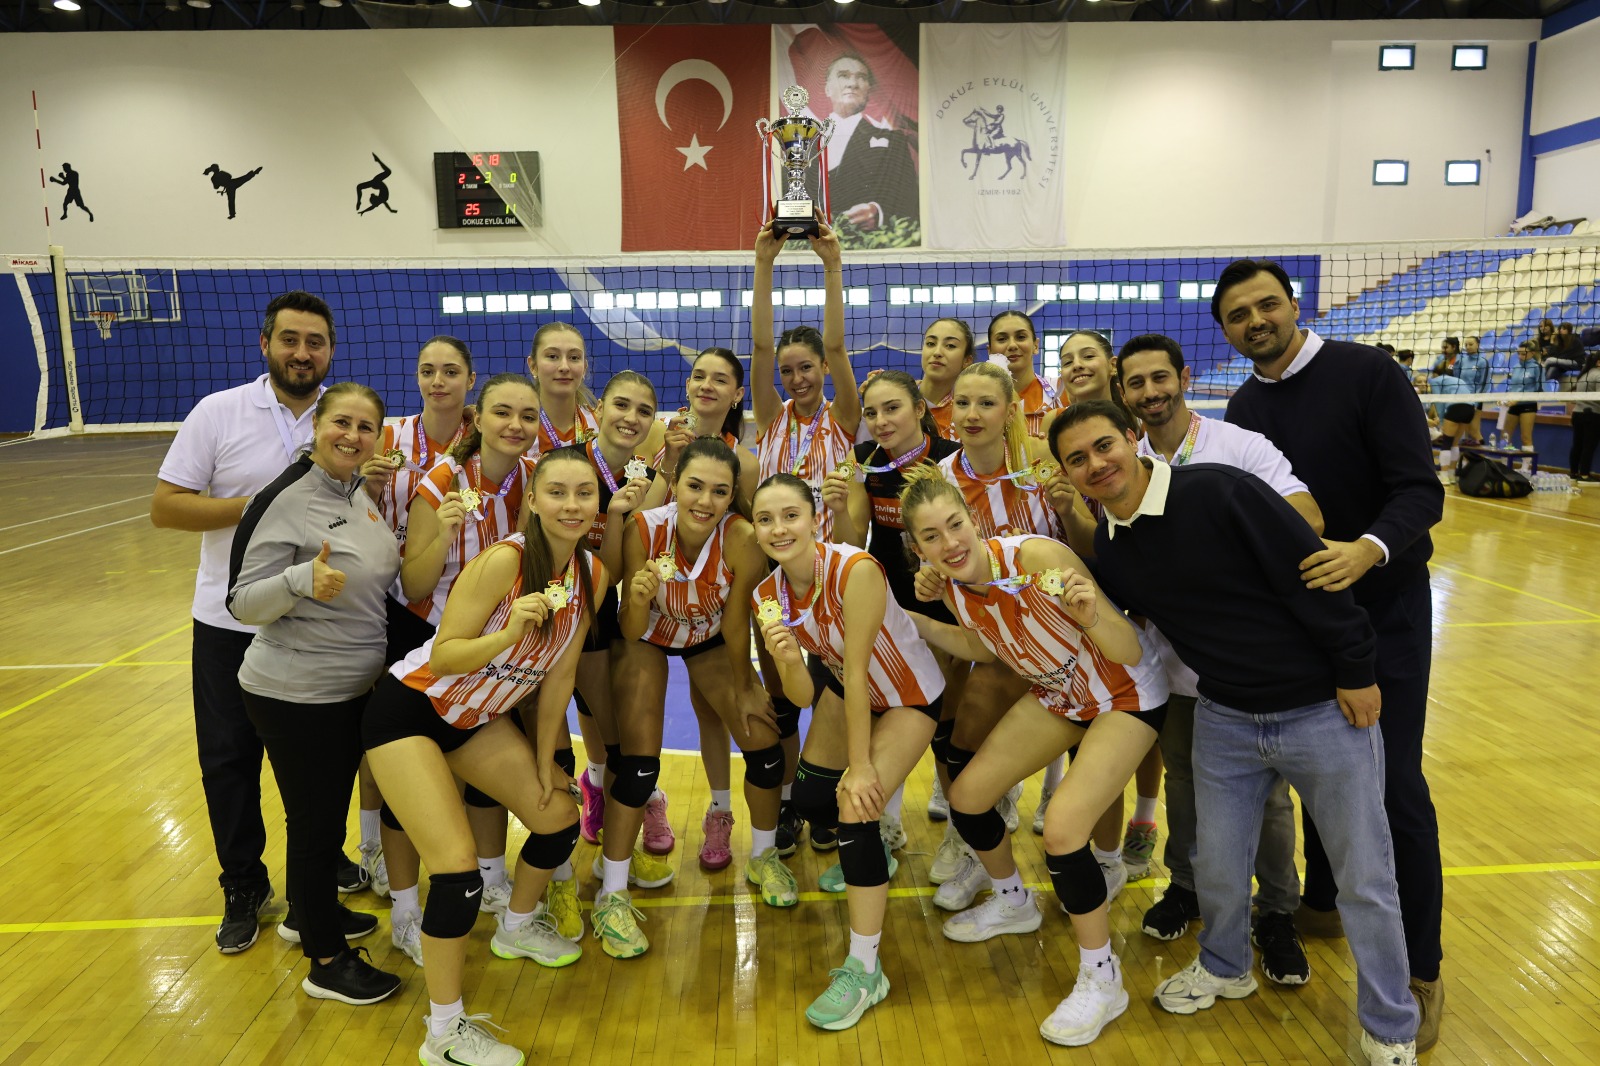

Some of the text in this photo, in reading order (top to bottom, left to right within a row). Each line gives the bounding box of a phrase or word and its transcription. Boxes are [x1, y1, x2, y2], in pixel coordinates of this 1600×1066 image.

[935, 81, 975, 120] DOKUZ
[982, 77, 1025, 94] EYLÜL
[458, 174, 465, 184] 2
[510, 173, 517, 183] 0
[465, 203, 480, 216] 25
[462, 218, 484, 226] DOKUZ
[485, 217, 505, 225] EYLÜL
